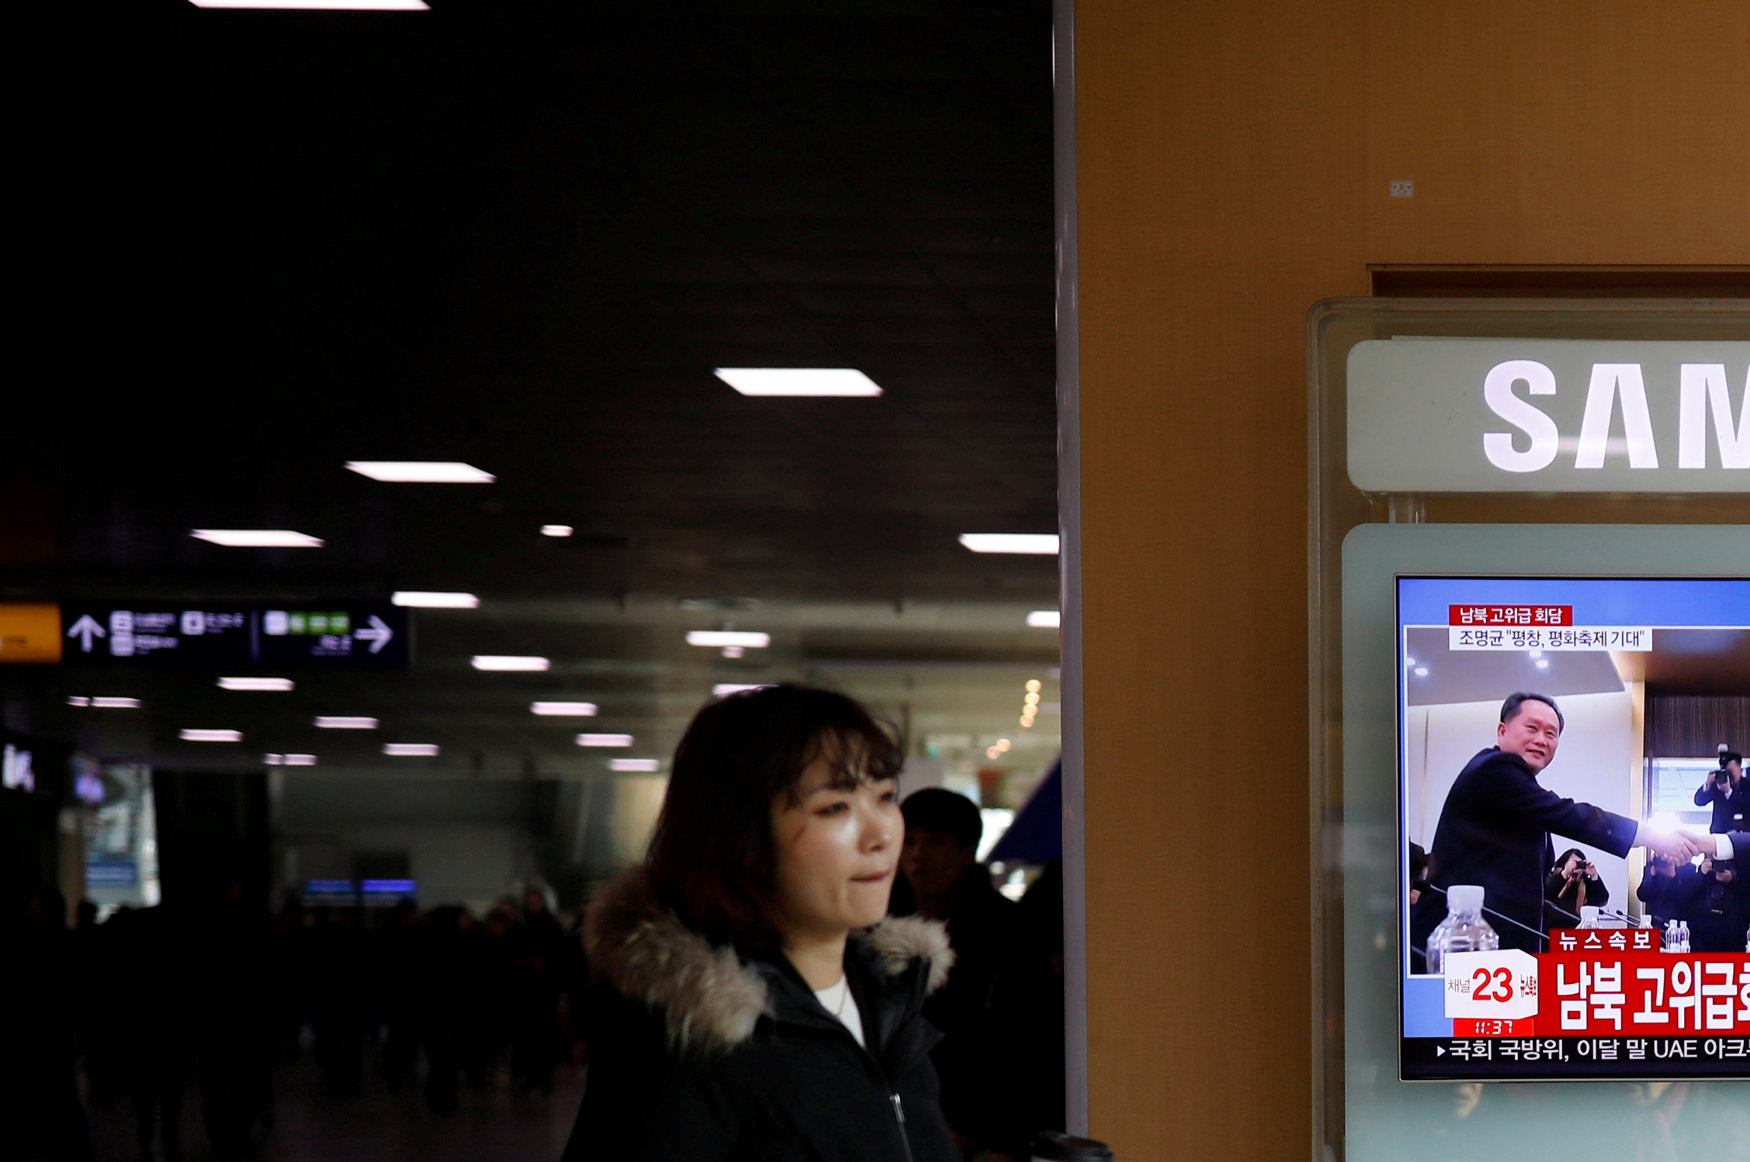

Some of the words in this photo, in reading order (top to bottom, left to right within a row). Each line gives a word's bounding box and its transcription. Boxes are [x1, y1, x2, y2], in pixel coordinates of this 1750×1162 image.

[1459, 608, 1488, 624] 남북
[1490, 608, 1532, 624] 고위급
[1535, 608, 1563, 624] 회담
[1459, 630, 1504, 647] 조명균
[1506, 630, 1545, 649] "평창,
[1549, 630, 1608, 647] 평화축제
[1611, 630, 1645, 647] 기대"
[1559, 931, 1651, 951] 뉴스속보
[1448, 978, 1471, 994] 채널
[1472, 967, 1513, 1002] 23
[1556, 961, 1626, 1030] 남북
[1449, 1040, 1492, 1061] 국회
[1499, 1039, 1569, 1062] 국방위,
[1577, 1039, 1620, 1060] 이달
[1626, 1039, 1648, 1060] 말
[1654, 1041, 1698, 1058] UAE
